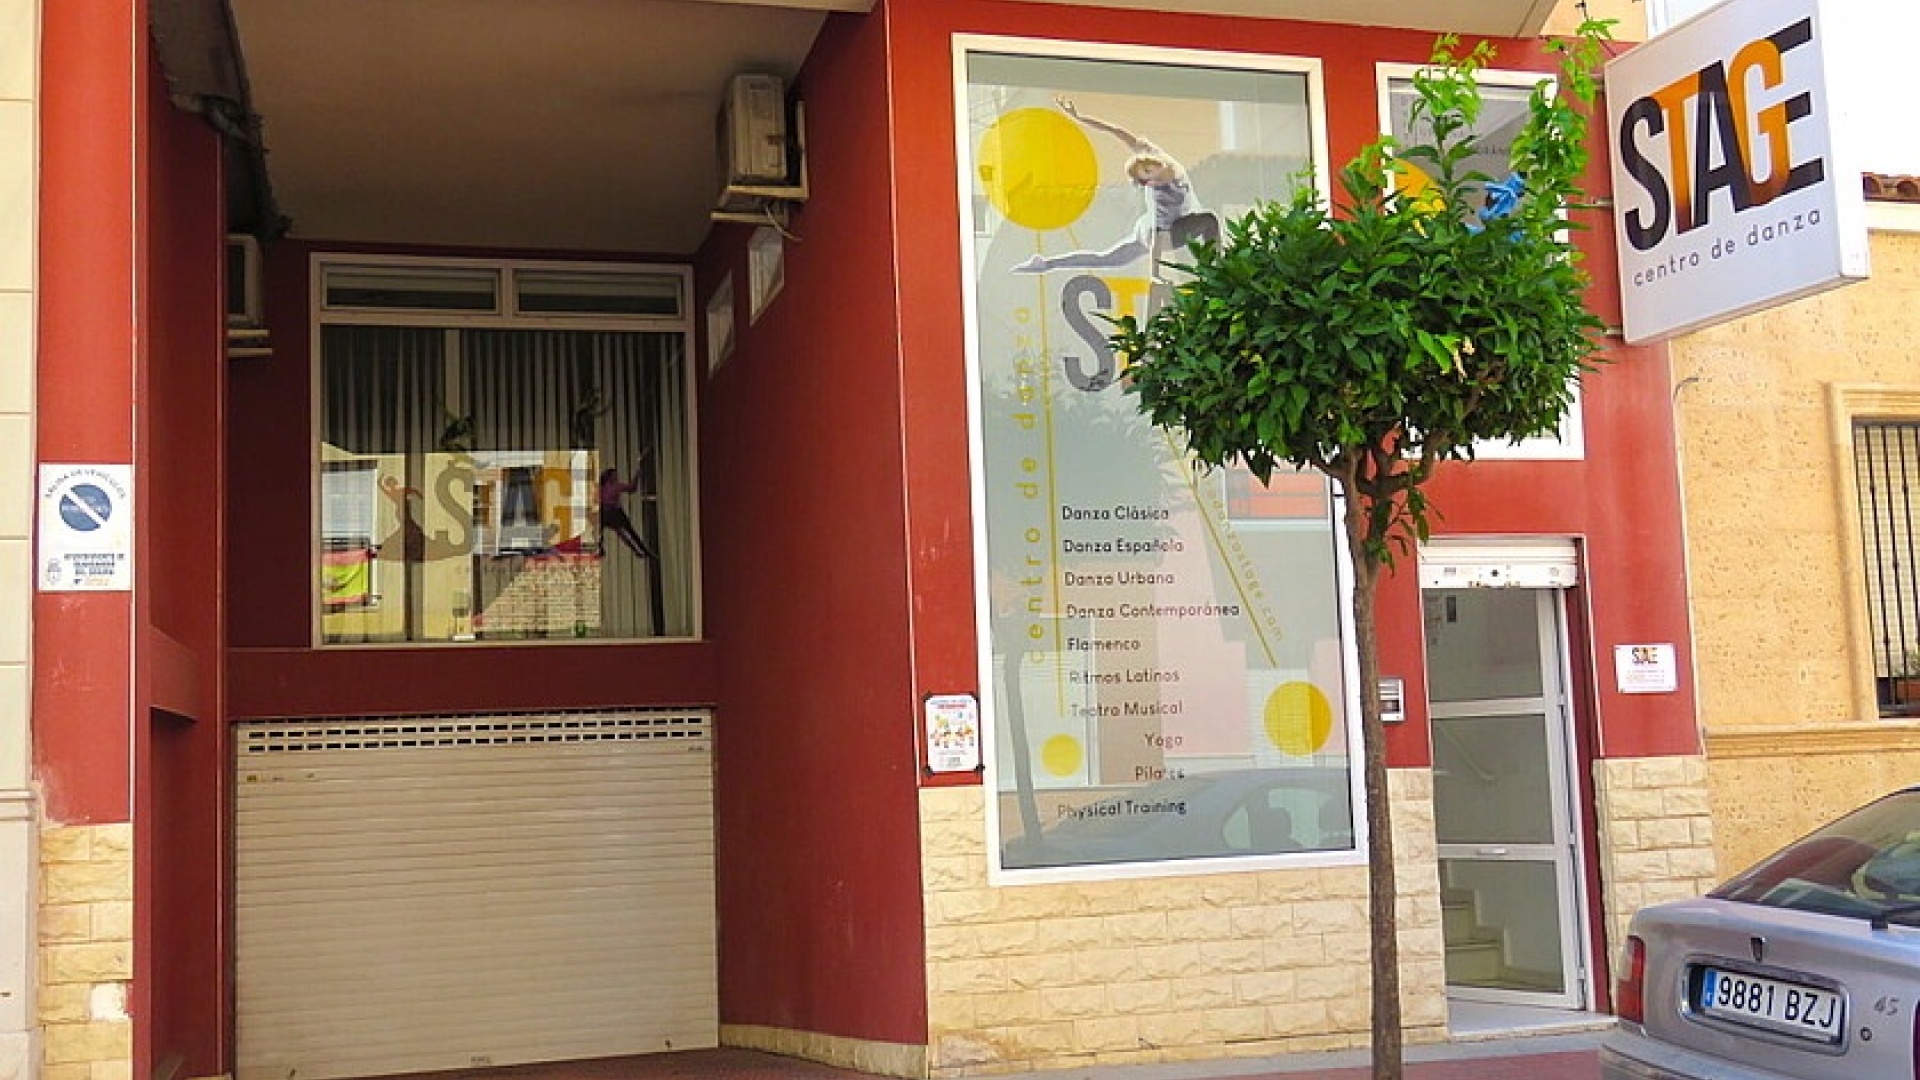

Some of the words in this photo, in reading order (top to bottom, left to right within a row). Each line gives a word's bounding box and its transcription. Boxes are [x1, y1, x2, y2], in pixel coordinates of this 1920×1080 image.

[1620, 16, 1825, 251] STAGE
[1633, 250, 1700, 287] centro
[1710, 238, 1736, 260] de
[1747, 208, 1821, 247] danza
[1013, 457, 1039, 498] de
[1062, 505, 1110, 520] Danza
[1114, 504, 1169, 520] Clásica
[1063, 539, 1112, 553] Danza
[1116, 538, 1183, 556] Española
[1064, 572, 1114, 586] Danza
[1117, 571, 1174, 585] Urbana
[1019, 527, 1045, 664] centro
[1066, 604, 1115, 619] Danza
[1119, 602, 1240, 618] Contemporánea
[1067, 637, 1141, 651] Flamenco
[1069, 669, 1122, 684] Ritmos
[1126, 669, 1180, 683] Latinos
[1124, 700, 1182, 716] Musical
[1144, 733, 1183, 749] Yoga
[1057, 802, 1121, 821] Physical
[1126, 801, 1187, 815] Training
[1717, 976, 1775, 1016] 9881
[1784, 989, 1836, 1028] BZJ
